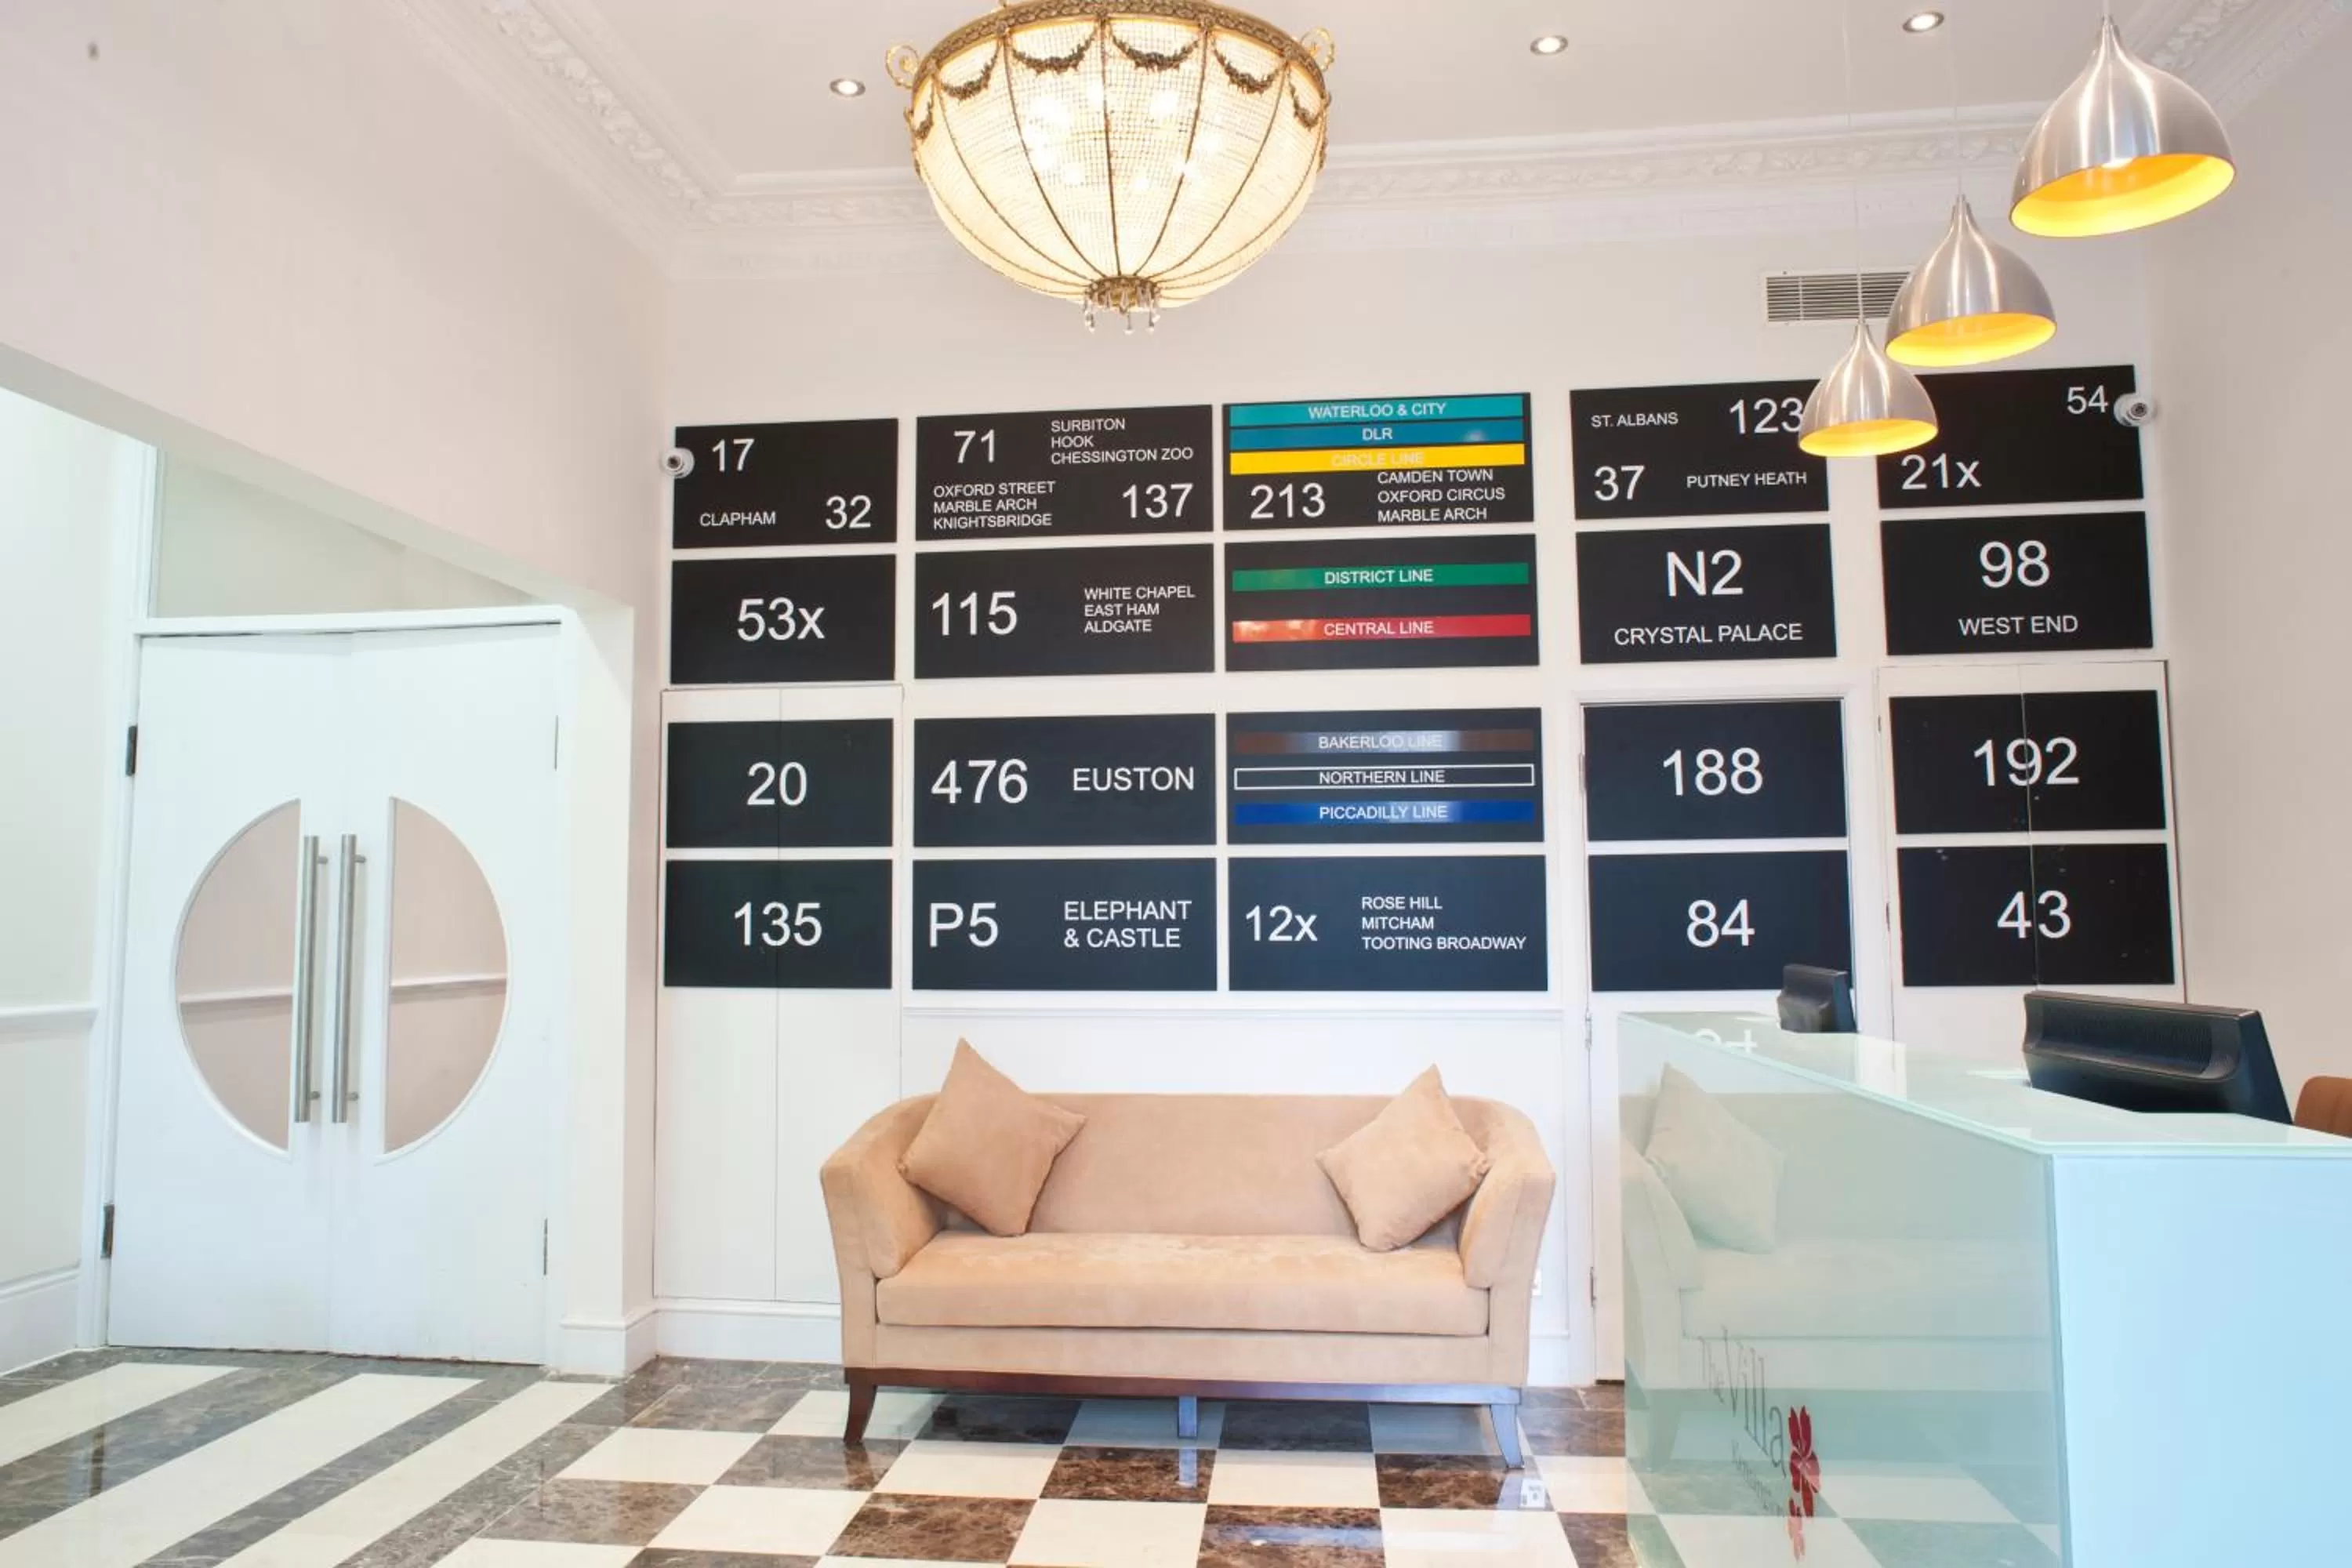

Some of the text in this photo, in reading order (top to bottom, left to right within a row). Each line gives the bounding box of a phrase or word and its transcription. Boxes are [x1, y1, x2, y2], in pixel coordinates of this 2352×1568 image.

[2067, 386, 2108, 415] 54
[1308, 402, 1446, 419] WATERLOO & CITY
[1592, 411, 1679, 428] ST. ALBANS
[1730, 398, 1803, 434] 123
[1051, 419, 1125, 433] SURBITON
[1363, 428, 1392, 441] DLR
[953, 430, 995, 463] 71
[1051, 436, 1094, 448] HOOK
[711, 439, 754, 472] 17
[1051, 448, 1193, 464] CHESSINGTON ZOO
[1331, 452, 1424, 466] CIRCLE LINE
[1378, 470, 1493, 484] CAMDEN TOWN
[1687, 471, 1806, 488] PUTNEY HEATH
[1901, 454, 1981, 491] 21x
[934, 481, 1055, 498] OXFORD STREET
[1595, 465, 1644, 501] 37
[1123, 484, 1193, 517] 137
[1250, 482, 1325, 518] 213
[1378, 487, 1504, 503] OXFORD CIRCUS
[826, 495, 871, 528] 32
[934, 497, 1036, 514] MARBLE ARCH
[1378, 508, 1486, 522] MARBLE ARCH
[700, 511, 775, 527] CLAPHAM
[935, 514, 1052, 529] KNIGHTSBRIDGE
[1980, 540, 2049, 587] 98
[1324, 569, 1433, 584] DISTRICT LINE
[1667, 550, 1743, 597] N2
[1084, 586, 1195, 601] WHITE CHAPEL
[738, 597, 825, 642] 53x
[932, 591, 1017, 636] 115
[1085, 603, 1160, 617] EAST HAM
[1085, 619, 1152, 633] ALDGATE
[1324, 621, 1434, 636] CENTRAL LINE
[1614, 623, 1802, 646] CRYSTAL PALACE
[1959, 615, 2078, 635] WEST END
[1319, 735, 1443, 749] BAKERLOO LINE
[1973, 736, 2080, 786] 192
[931, 759, 1027, 804] 476
[1073, 767, 1194, 791] EUSTON
[1319, 770, 1445, 784] NORTHERN LINE
[1663, 747, 1762, 797] 188
[746, 762, 807, 806] 20
[1319, 806, 1447, 819] PICCADILLY LINE
[1065, 901, 1192, 920] ELEPHANT
[1362, 896, 1443, 910] ROSE HILL
[1246, 906, 1317, 941] 12x
[1362, 917, 1434, 929] MITCHAM
[1687, 898, 1755, 947] 84
[1998, 890, 2070, 938] 43
[735, 902, 822, 947] 135
[931, 902, 997, 947] P5
[1064, 928, 1180, 948] & CASTLE
[1362, 937, 1526, 949] TOOTING BROADWAY
